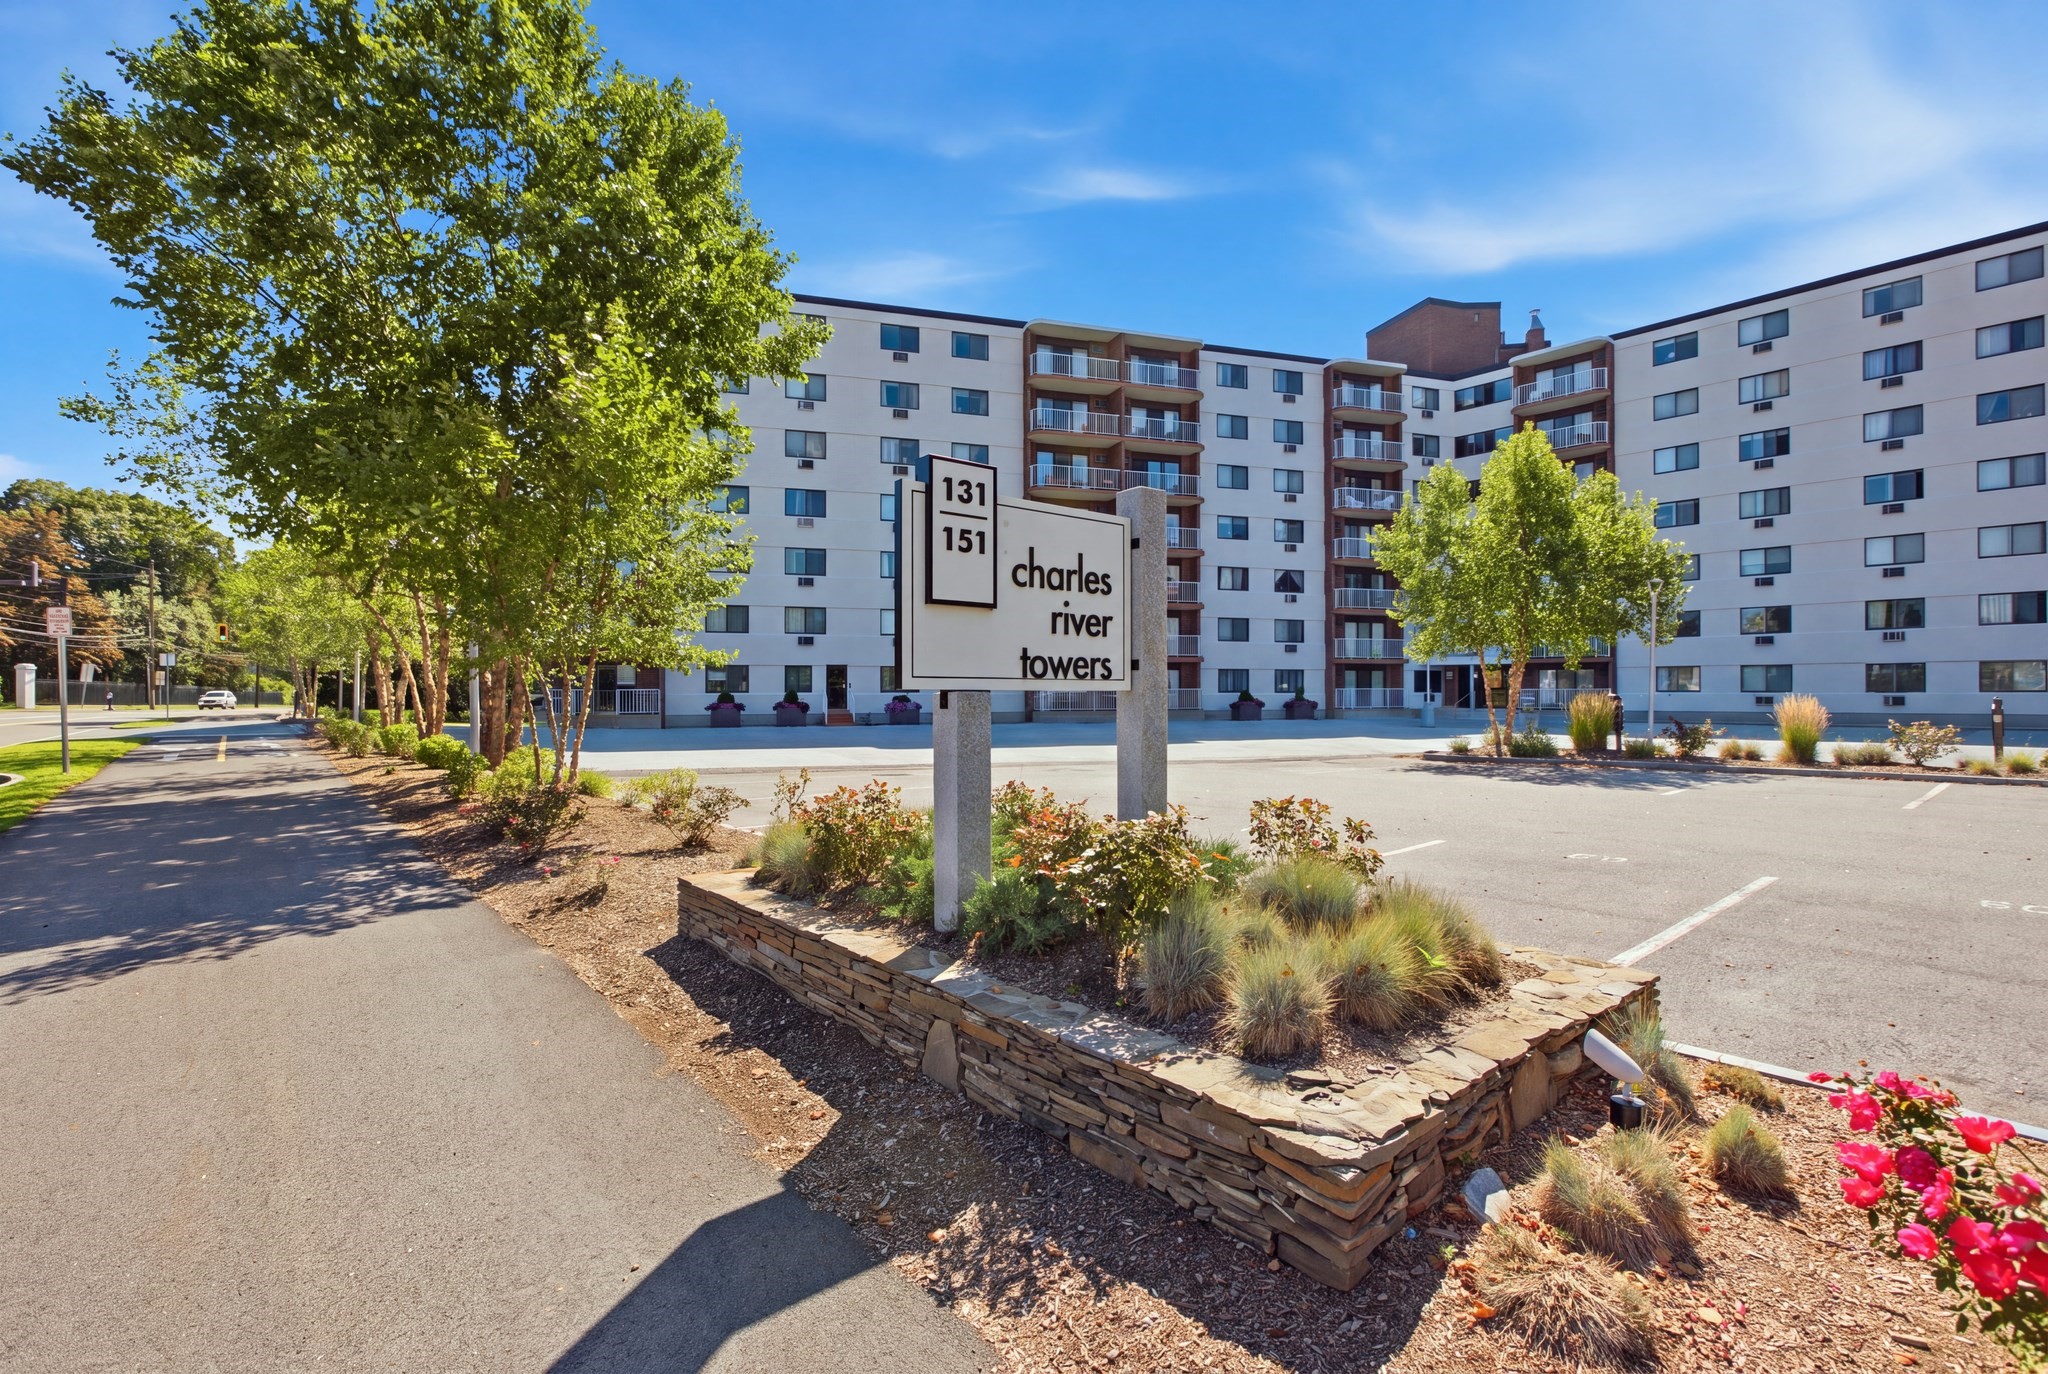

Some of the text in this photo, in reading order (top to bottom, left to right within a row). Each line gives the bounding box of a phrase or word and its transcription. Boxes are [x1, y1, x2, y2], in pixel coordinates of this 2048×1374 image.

[942, 476, 986, 506] 131
[942, 526, 986, 555] 151
[1011, 546, 1113, 596] charles
[1051, 600, 1114, 638] river
[1020, 647, 1113, 680] towers
